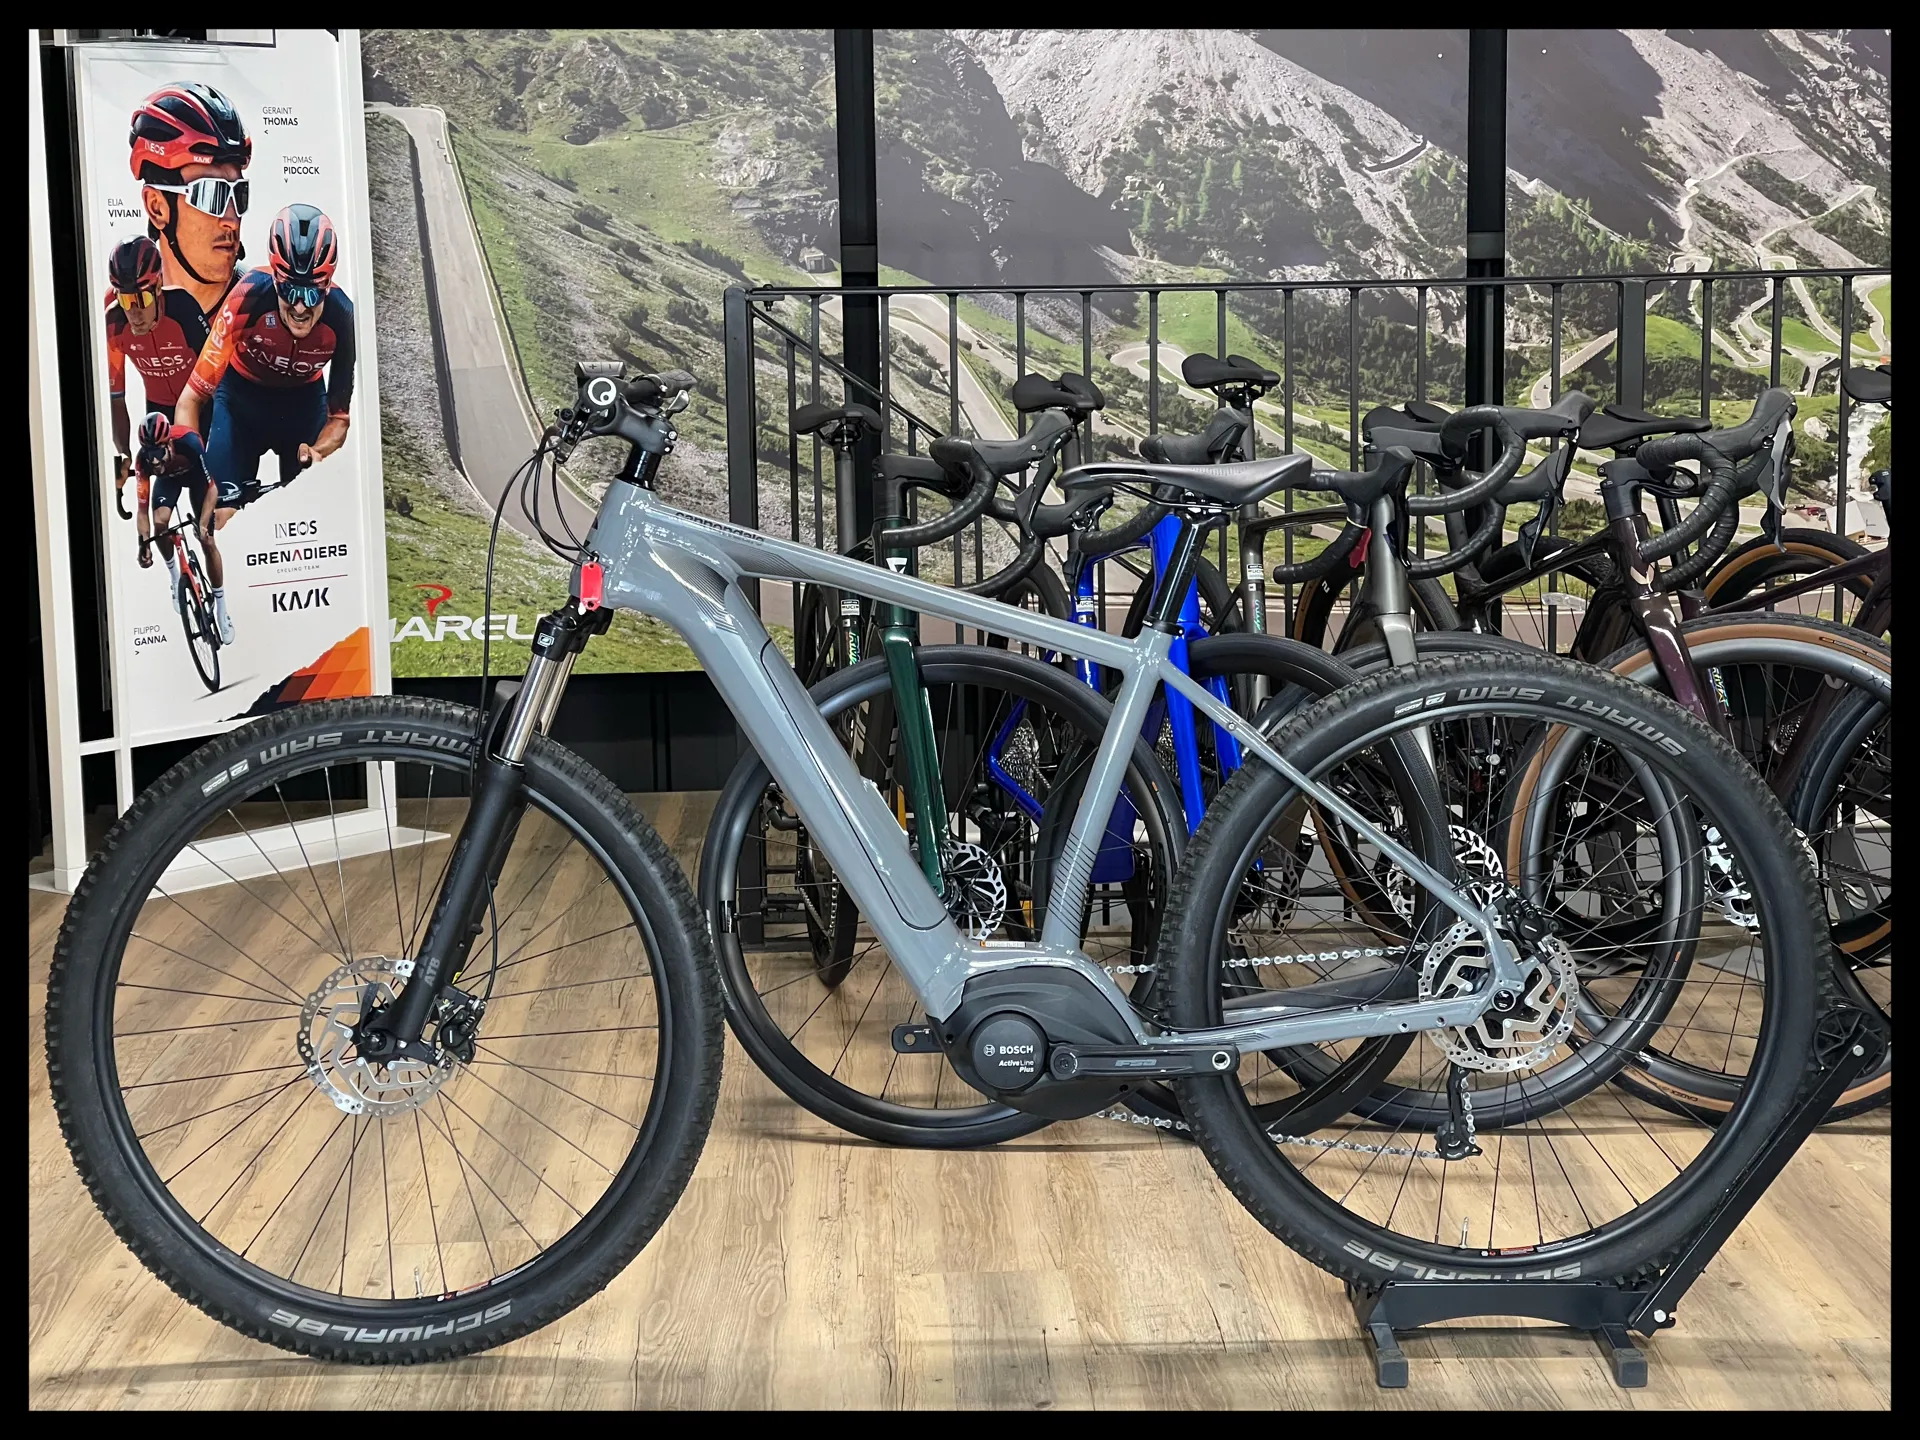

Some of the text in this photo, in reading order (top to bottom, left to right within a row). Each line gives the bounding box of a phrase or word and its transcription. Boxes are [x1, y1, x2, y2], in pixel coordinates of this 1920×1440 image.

[262, 106, 293, 115] GERAINT
[263, 117, 299, 127] THOMAS
[282, 155, 313, 164] THOMAS
[283, 165, 320, 176] PIDCOCK
[107, 198, 124, 207] ELIA
[108, 208, 142, 219] VIVIANI
[136, 354, 184, 368] INEOS
[274, 520, 318, 539] INEOS
[246, 544, 348, 567] GRENADIERS
[276, 566, 302, 574] CYCLING
[272, 586, 330, 613] KASK
[133, 624, 161, 636] FILIPPO
[134, 633, 168, 647] GANNA
[1457, 685, 1687, 757] SMART SAM
[259, 729, 472, 765] MART SAM
[1000, 1045, 1034, 1055] BOSCH
[267, 1299, 513, 1344] SCHWALBE
